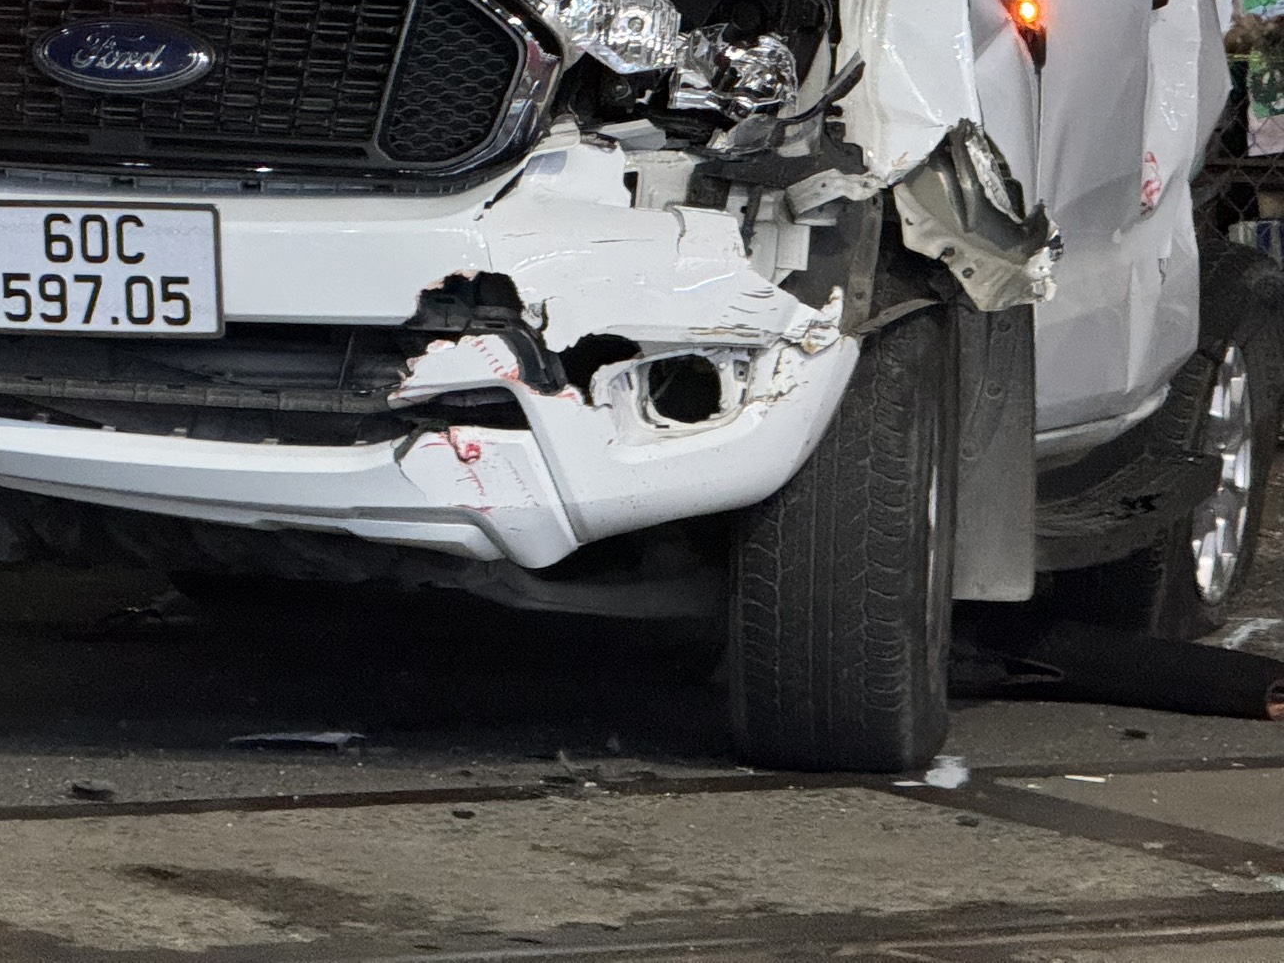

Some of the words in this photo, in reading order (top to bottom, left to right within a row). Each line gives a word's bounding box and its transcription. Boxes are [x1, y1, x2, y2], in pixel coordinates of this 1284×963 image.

[72, 37, 164, 73] Ford
[43, 213, 145, 265] 60C
[2, 273, 192, 327] 597.05
